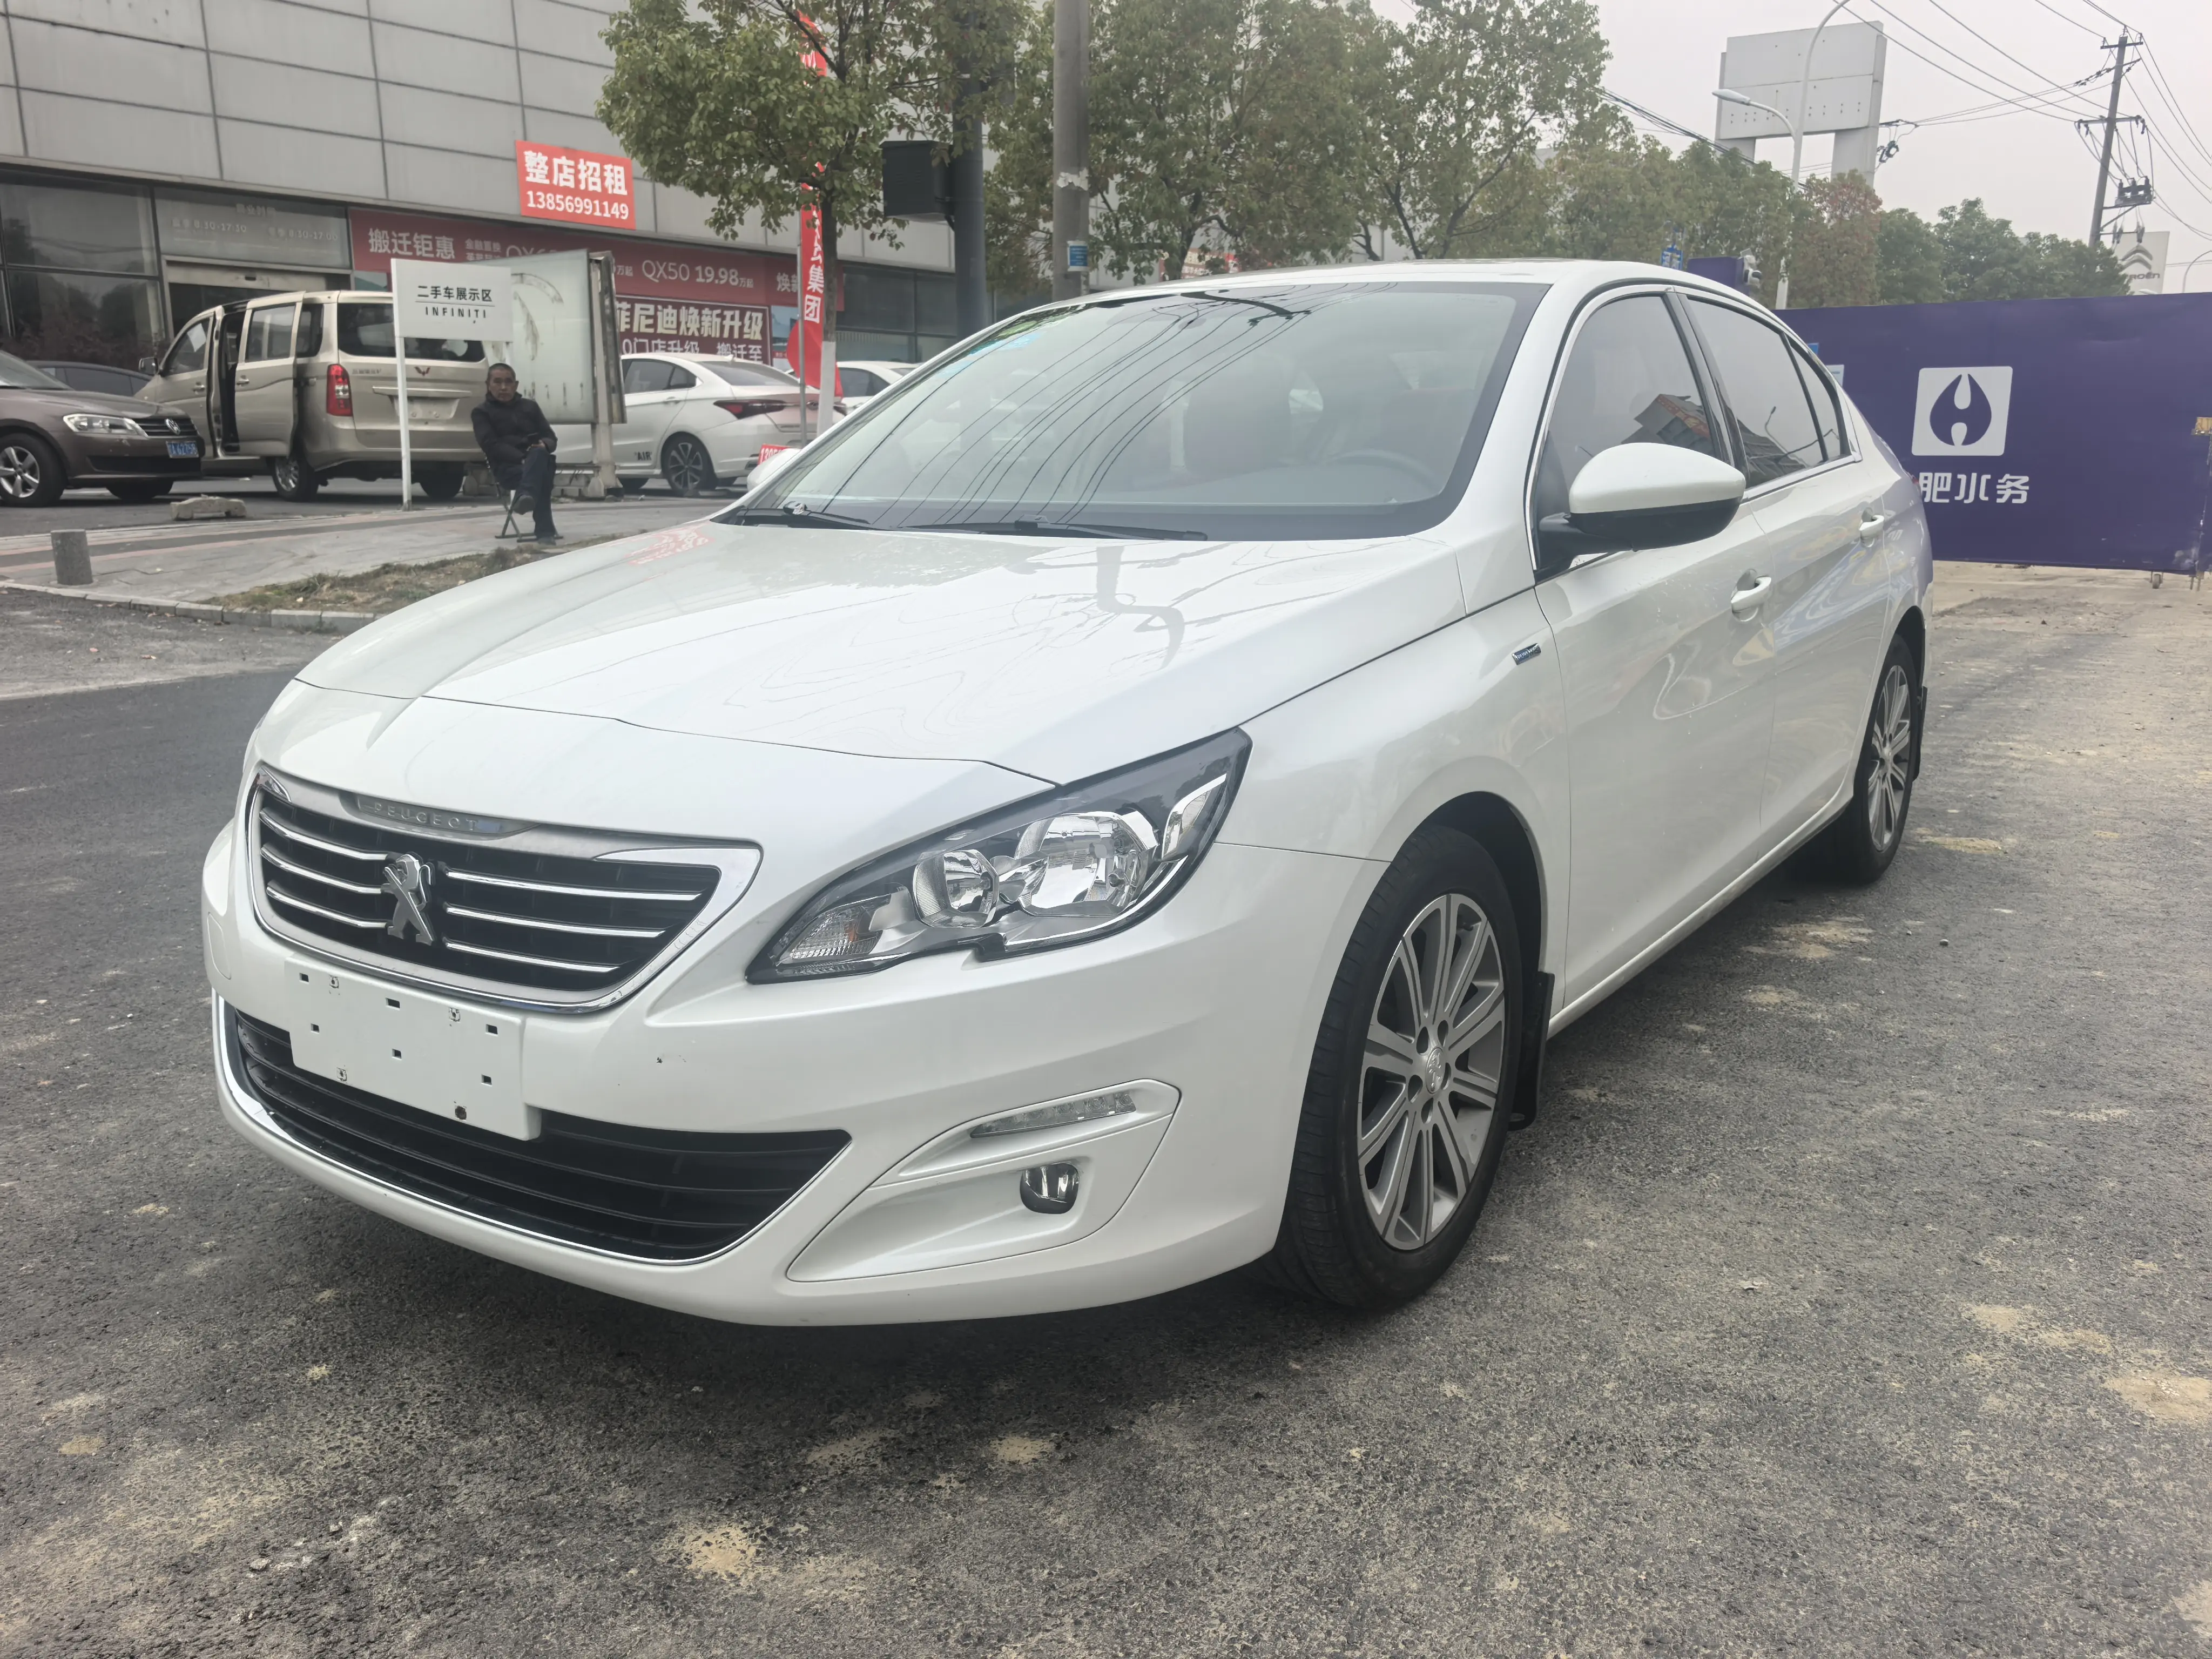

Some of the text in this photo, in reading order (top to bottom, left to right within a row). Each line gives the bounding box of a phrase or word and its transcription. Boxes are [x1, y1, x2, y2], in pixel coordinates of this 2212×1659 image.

[523, 150, 628, 195] 整店招租
[526, 190, 629, 220] 13856991149
[368, 227, 456, 260] 搬迁钜惠
[641, 260, 690, 283] QX50
[417, 285, 493, 302] 二手车展示区
[424, 306, 487, 319] INFINITI
[1919, 472, 2029, 504] 肥水务
[374, 801, 478, 831] PEUGEOT
